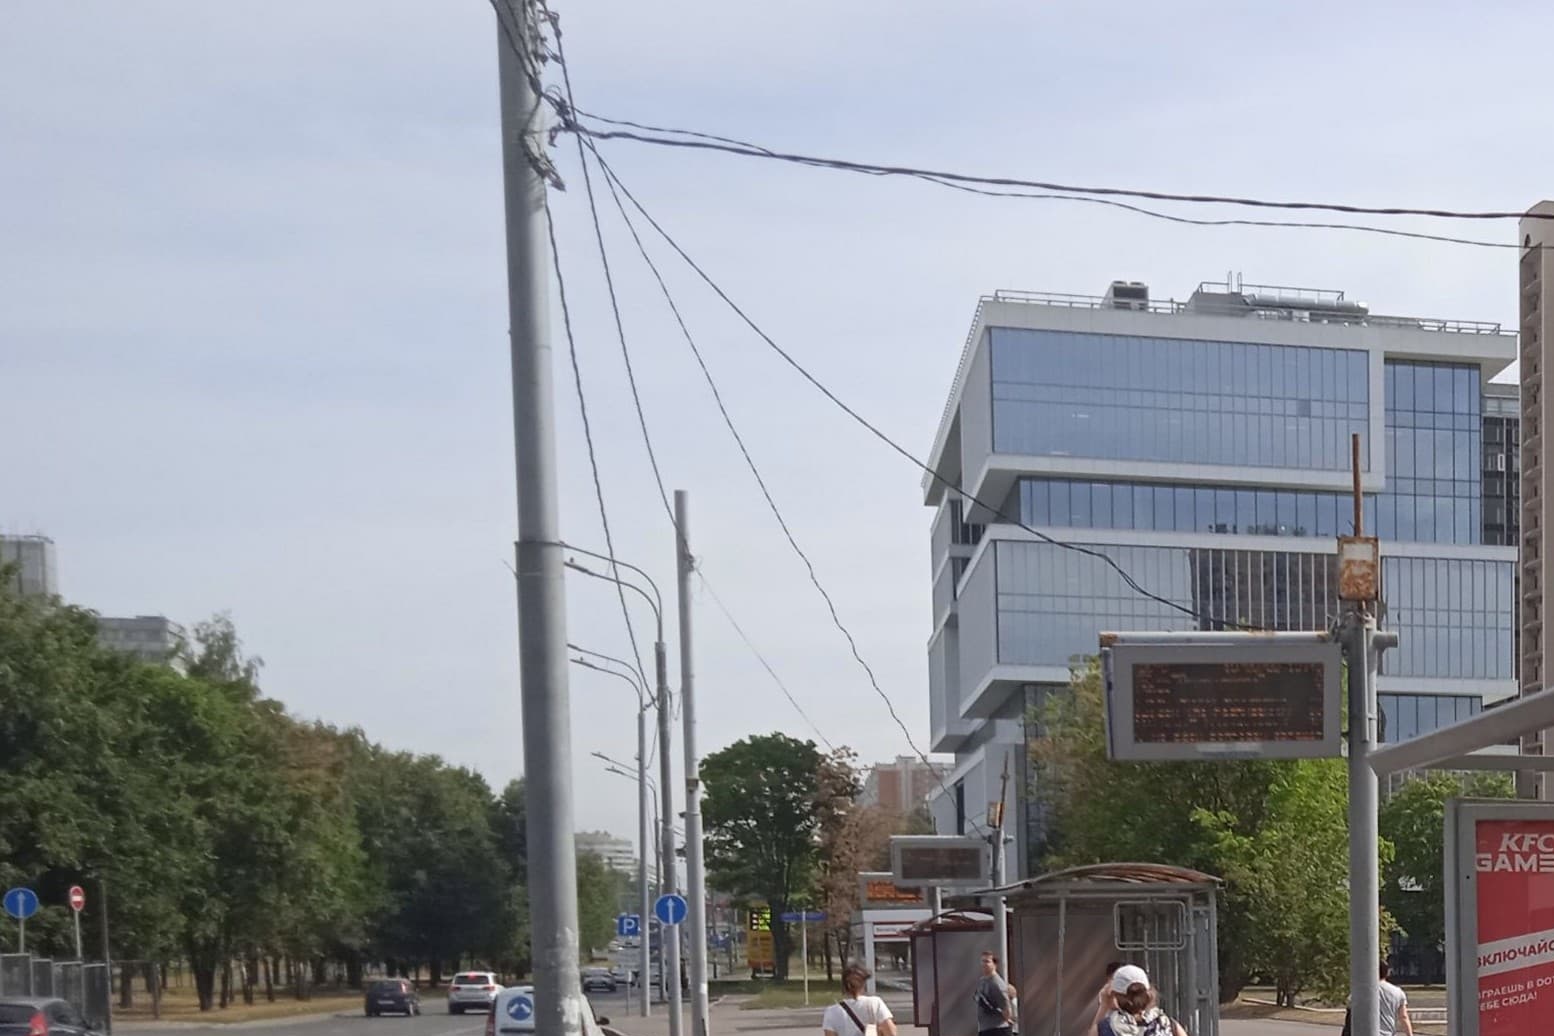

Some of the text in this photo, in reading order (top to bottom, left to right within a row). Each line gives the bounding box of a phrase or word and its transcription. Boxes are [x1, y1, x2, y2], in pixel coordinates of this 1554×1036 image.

[623, 918, 635, 934] P
[1526, 980, 1534, 990] В
[1479, 992, 1537, 1011] ЕБЕ СЮДА!
